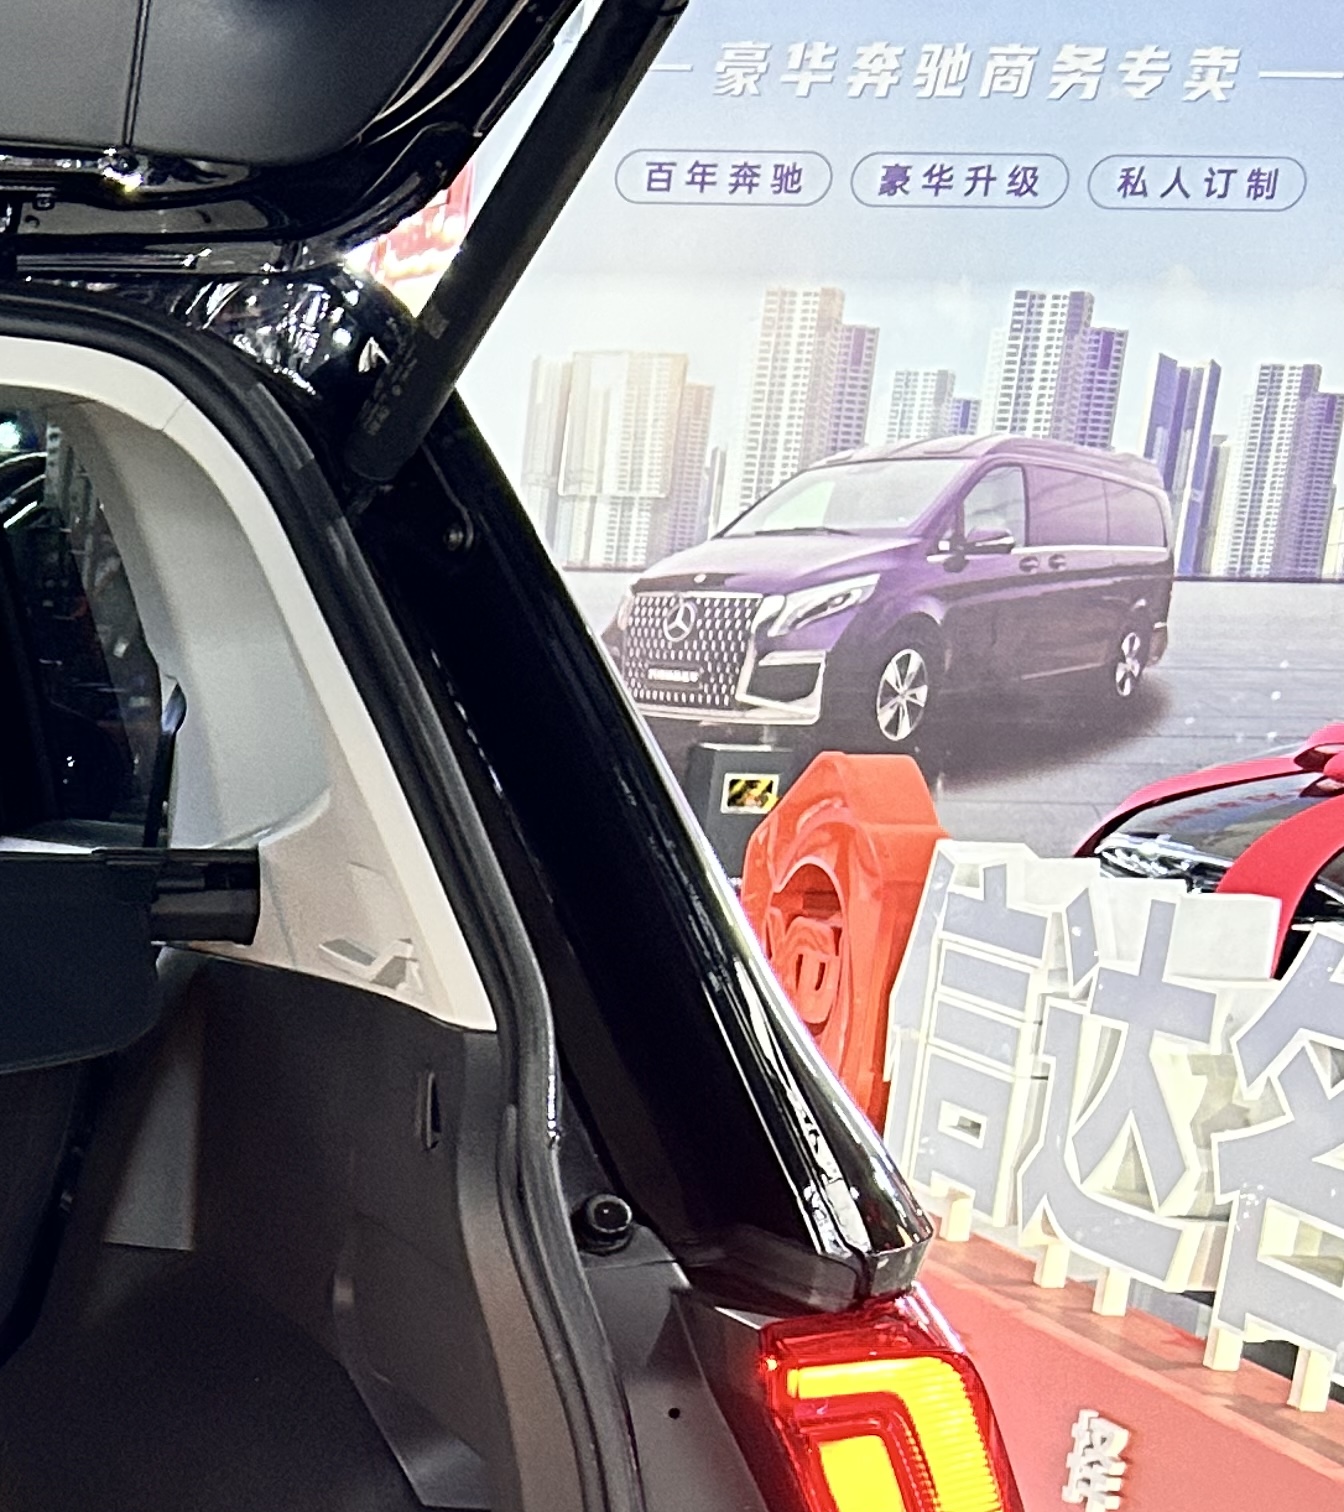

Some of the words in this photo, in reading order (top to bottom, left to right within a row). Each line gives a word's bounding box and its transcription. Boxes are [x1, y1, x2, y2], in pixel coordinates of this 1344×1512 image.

[713, 41, 1242, 102] 豪华奔驰商务专卖
[644, 160, 804, 195] 百年奔驰
[878, 162, 1042, 200] 豪华升级
[1116, 165, 1280, 202] 私人订制
